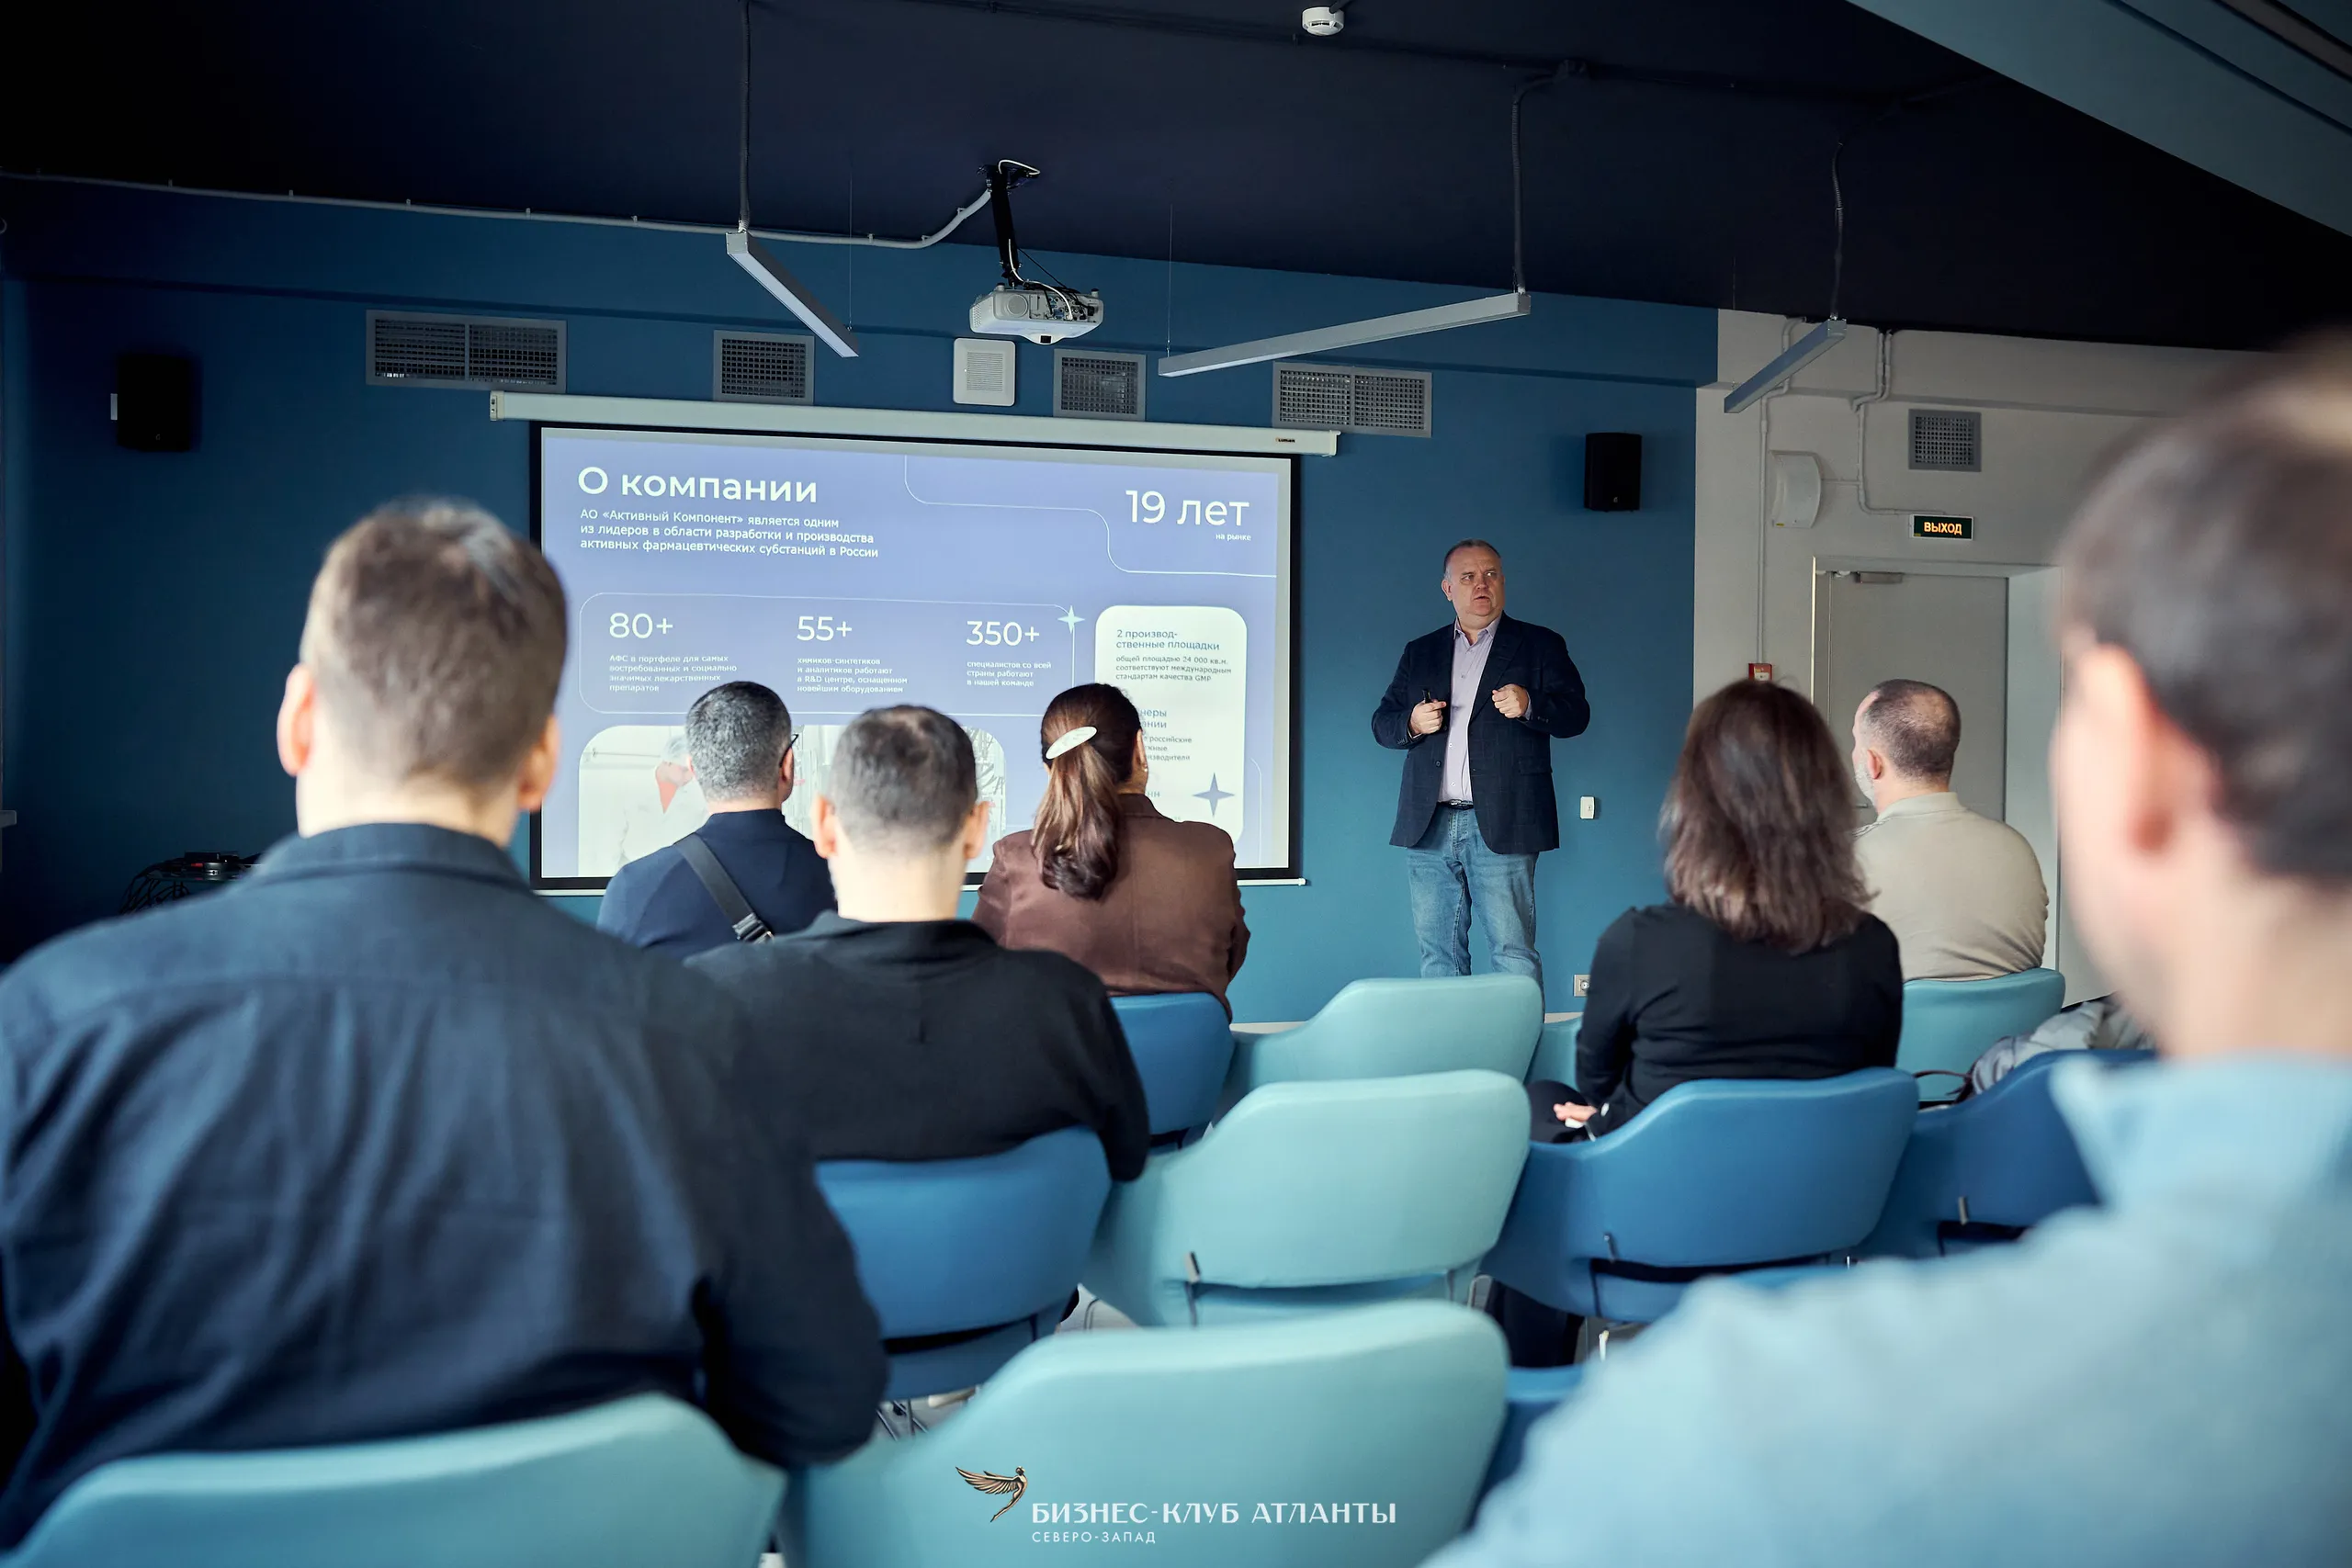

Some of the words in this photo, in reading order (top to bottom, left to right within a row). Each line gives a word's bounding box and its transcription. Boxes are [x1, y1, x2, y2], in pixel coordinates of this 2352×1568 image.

[578, 467, 608, 495] О
[621, 474, 818, 503] компании
[1125, 490, 1166, 525] 19
[1177, 501, 1250, 526] лет
[581, 509, 598, 520] АО
[603, 509, 669, 523] «Активный
[673, 512, 743, 525] Компонент»
[748, 516, 800, 527] является
[803, 519, 839, 529] одним
[1924, 522, 1962, 536] ВЫХОД
[581, 525, 594, 535] из
[598, 525, 649, 538] лидеров
[653, 528, 660, 536] в
[663, 525, 712, 538] области
[716, 528, 782, 541] разработки
[786, 532, 793, 540] и
[797, 532, 875, 545] производства
[1227, 533, 1251, 543] рынке
[580, 540, 639, 550] активных
[643, 539, 755, 555] фармацевтических
[760, 542, 826, 557] субстанций
[830, 547, 836, 556] в
[840, 547, 879, 559] России
[609, 613, 673, 638] 80+
[797, 615, 853, 641] 55+
[967, 621, 1040, 646] 350+
[1117, 629, 1123, 638] 2
[1125, 631, 1178, 640] производ-
[1168, 641, 1220, 650] площадки
[683, 656, 699, 664] для
